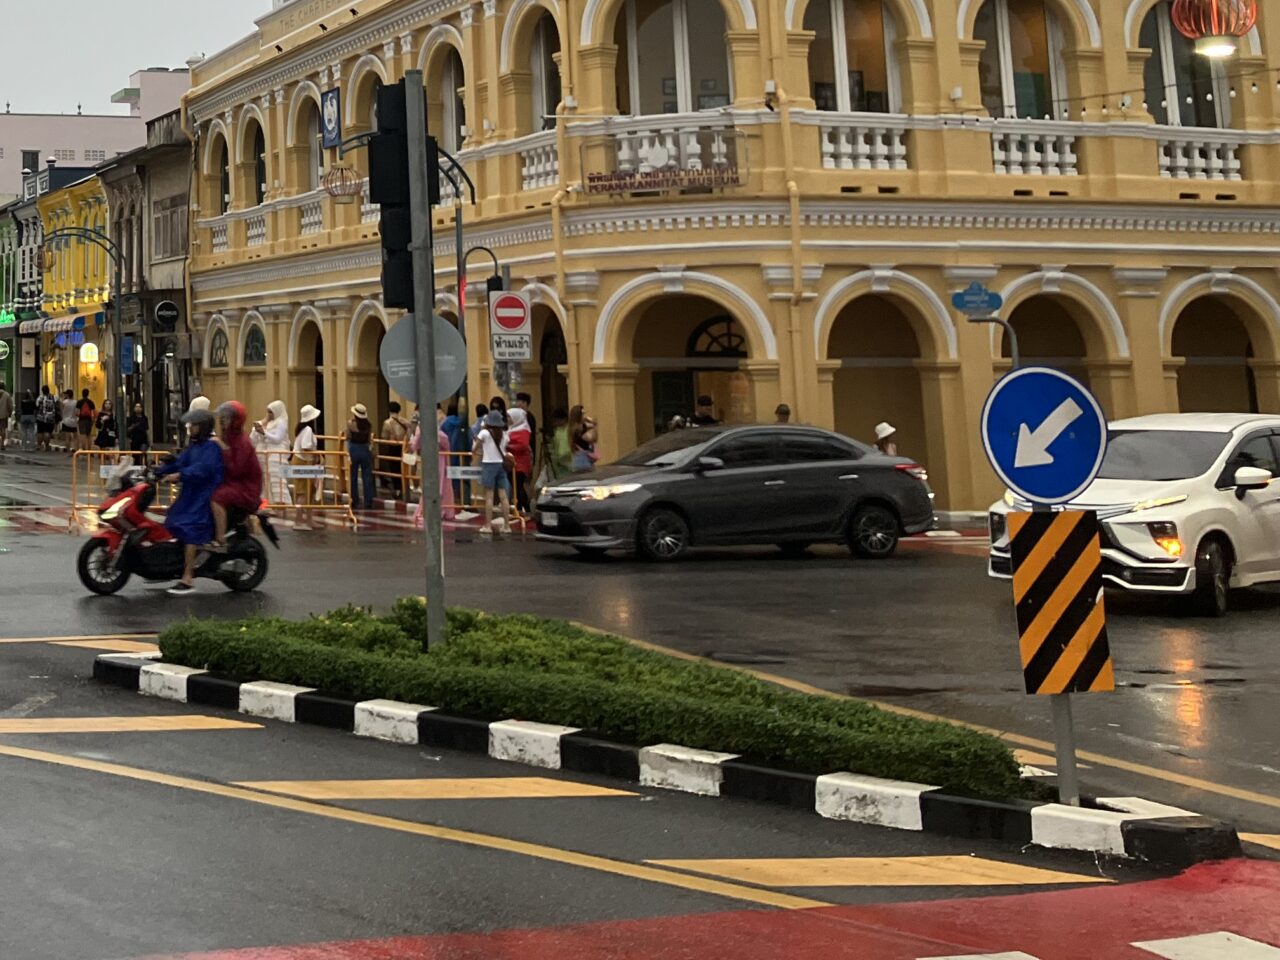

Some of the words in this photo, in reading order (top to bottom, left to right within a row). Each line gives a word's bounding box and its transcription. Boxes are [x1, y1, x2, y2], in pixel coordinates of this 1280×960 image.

[280, 14, 296, 33] THE
[688, 175, 740, 187] MUSEUM
[495, 336, 528, 348] ห้ามเข้า
